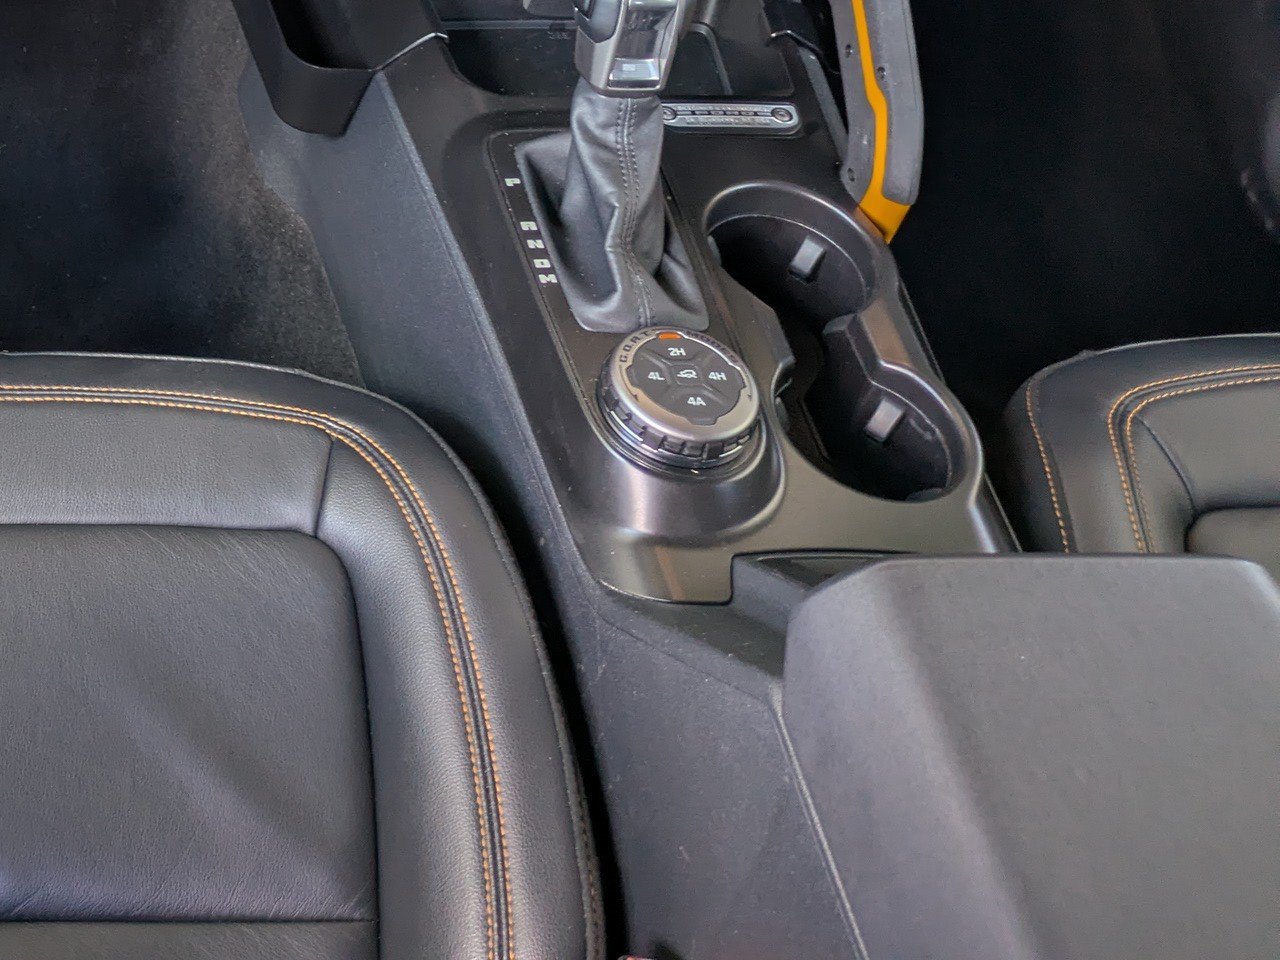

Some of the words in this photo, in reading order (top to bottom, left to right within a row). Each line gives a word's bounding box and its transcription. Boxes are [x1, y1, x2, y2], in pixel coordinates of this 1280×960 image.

[504, 177, 522, 187] P
[526, 239, 545, 249] N
[533, 258, 551, 269] D
[538, 273, 558, 284] M
[667, 347, 687, 357] 2H
[647, 371, 666, 381] 4L
[708, 371, 727, 381] 4H
[686, 396, 707, 407] 4A
